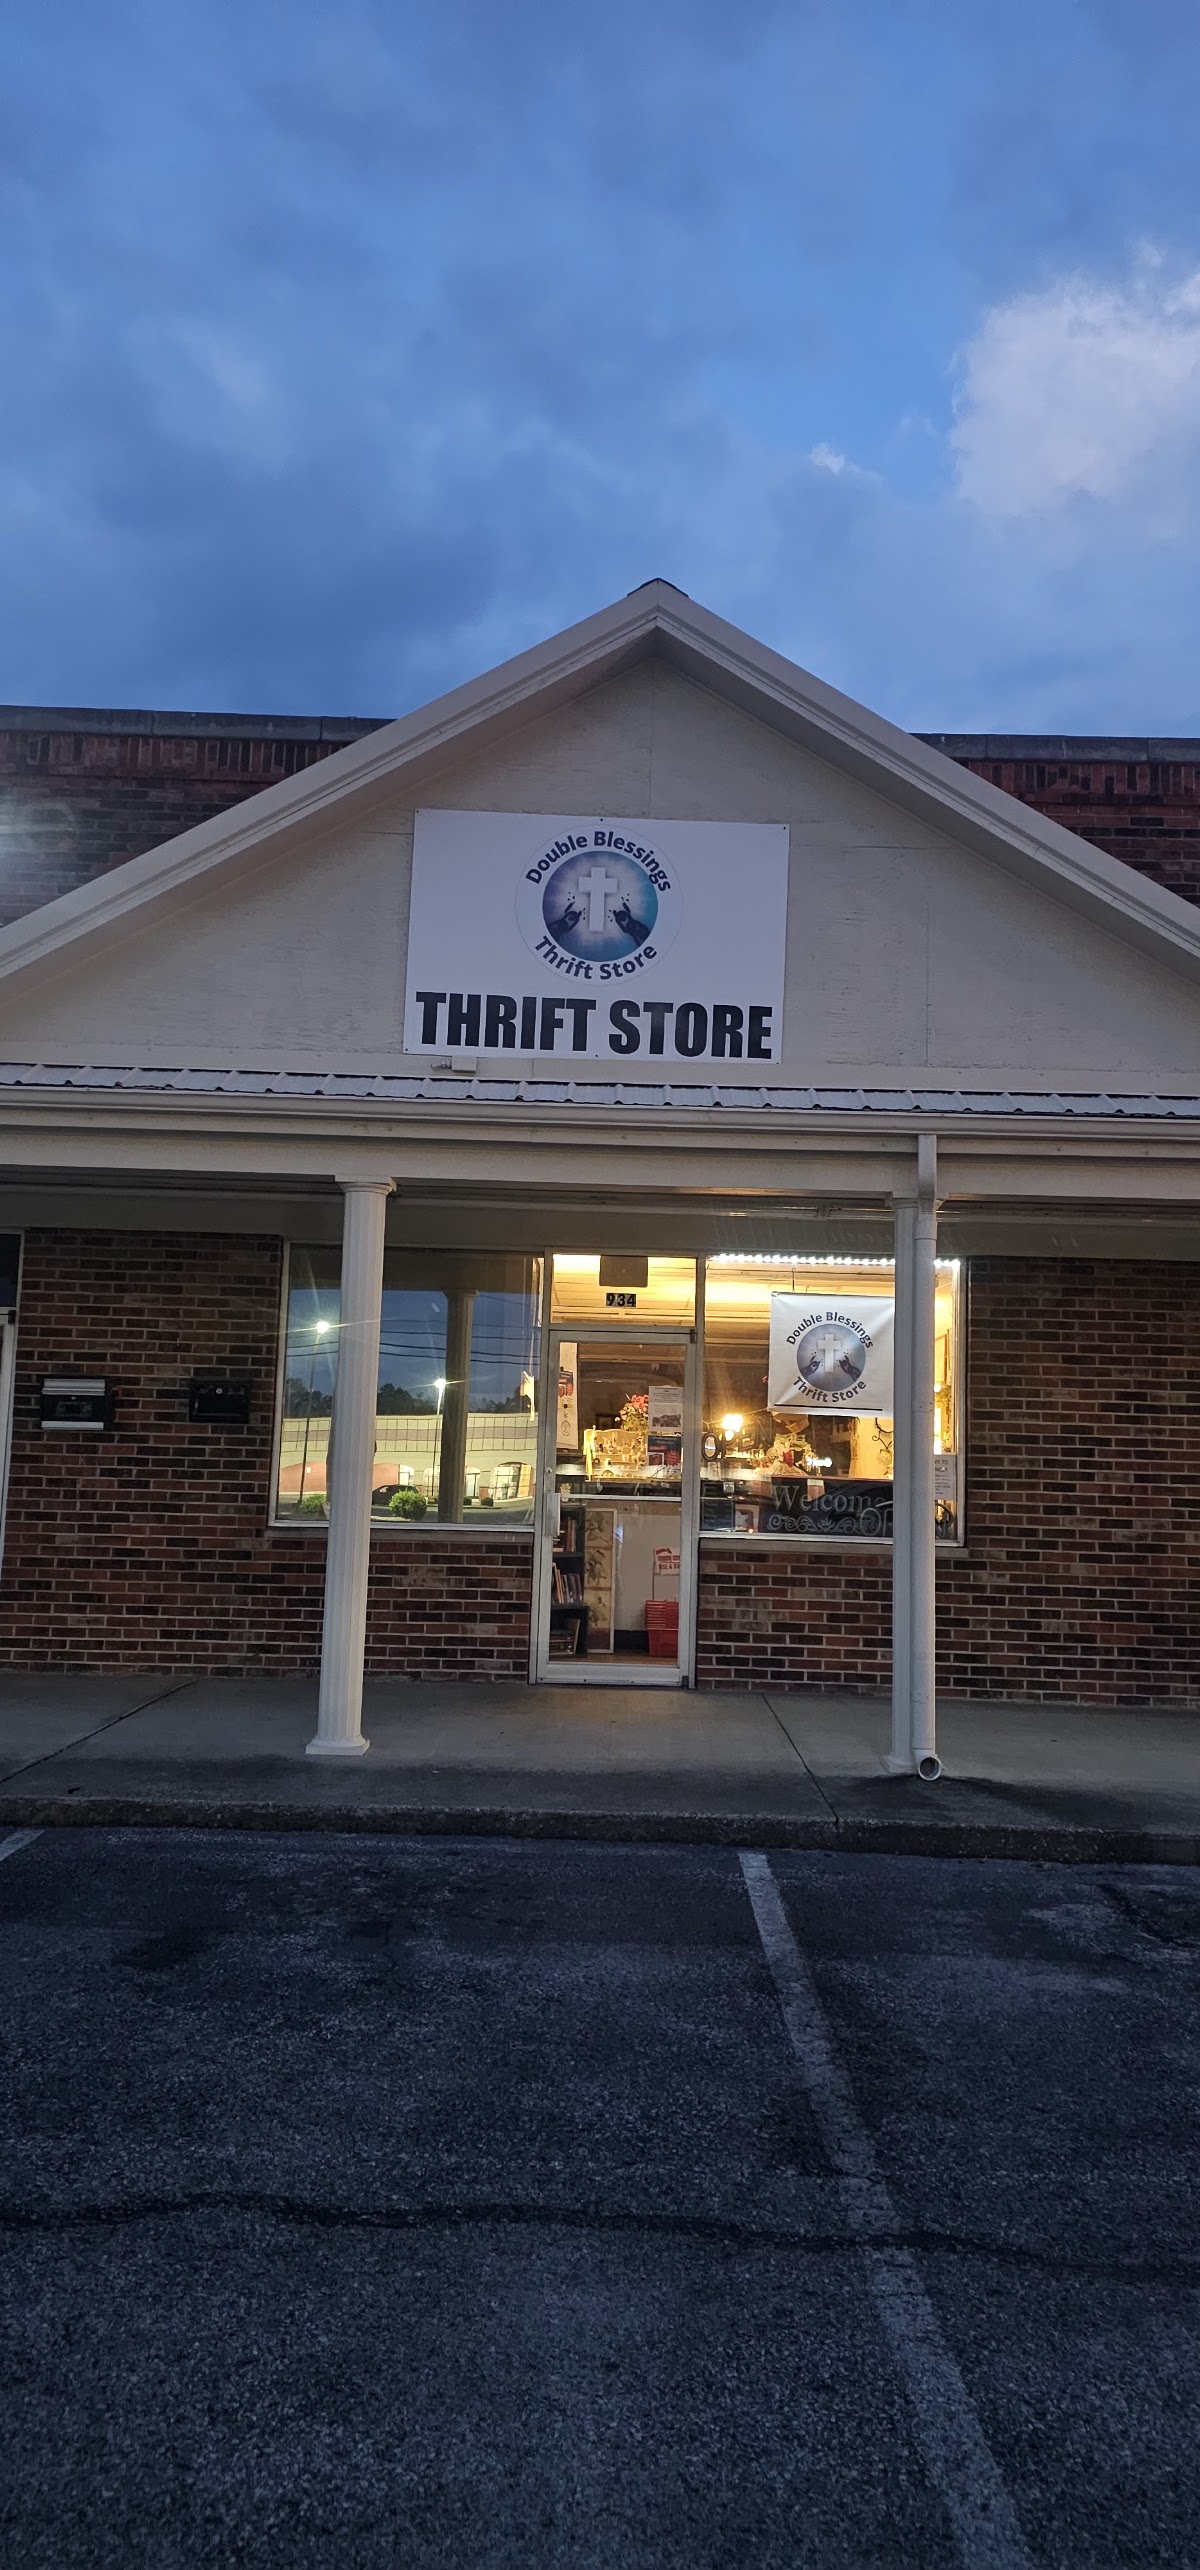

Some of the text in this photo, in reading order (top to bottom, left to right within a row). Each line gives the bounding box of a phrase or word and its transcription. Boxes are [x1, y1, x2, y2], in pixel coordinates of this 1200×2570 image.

[525, 831, 671, 892] Double Blessings
[534, 935, 658, 980] Thrift Store
[415, 991, 773, 1059] THRIFT STORE
[606, 1293, 636, 1307] 934
[786, 1312, 874, 1349] Double Blessings
[793, 1376, 867, 1403] Thrift Store
